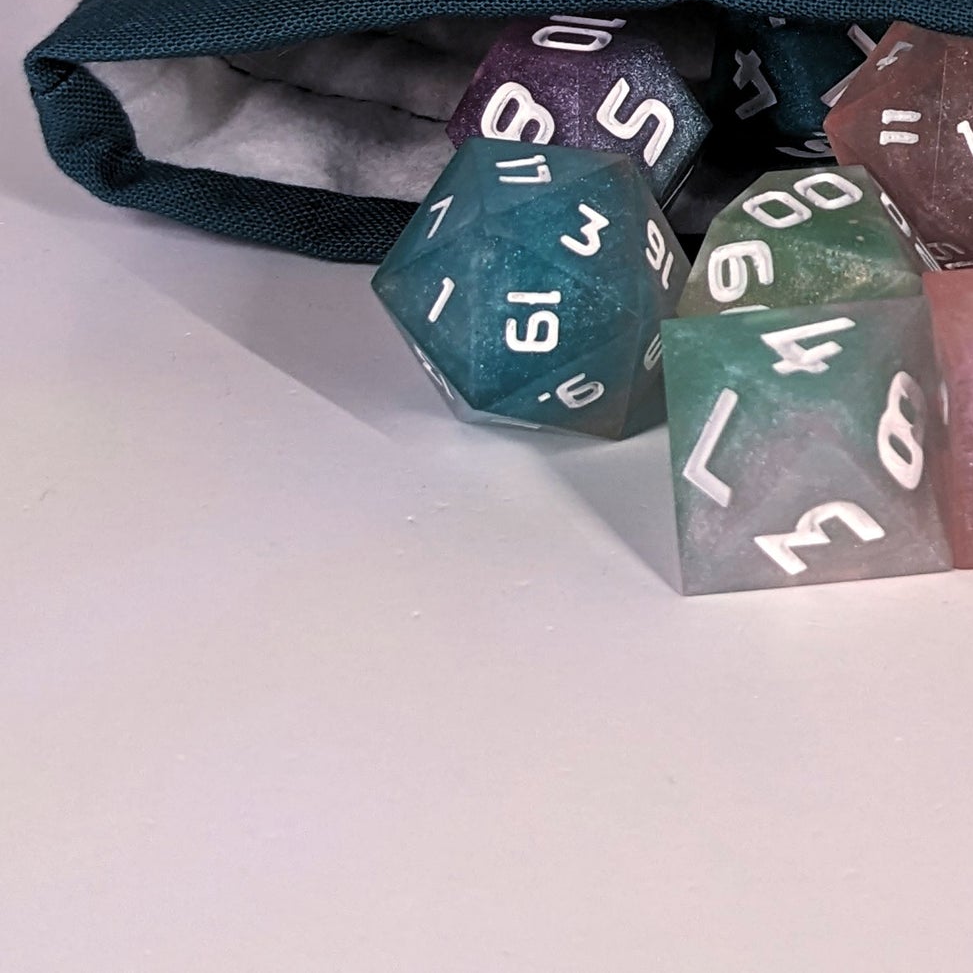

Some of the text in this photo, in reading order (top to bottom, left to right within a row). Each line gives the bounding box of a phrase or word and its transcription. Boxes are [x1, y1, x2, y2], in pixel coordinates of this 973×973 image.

[531, 14, 627, 52] 10
[732, 49, 778, 120] 4
[596, 77, 675, 167] 5
[878, 108, 922, 146] 11
[495, 154, 552, 184] 17
[427, 194, 454, 239] 7
[742, 172, 863, 228] 00
[559, 203, 610, 257] 3
[427, 276, 455, 324] 1
[707, 239, 775, 315] 6
[505, 290, 563, 353] 19
[760, 317, 857, 375] 4
[682, 387, 739, 508] 7
[877, 370, 925, 491] 8
[754, 501, 886, 576] 3
